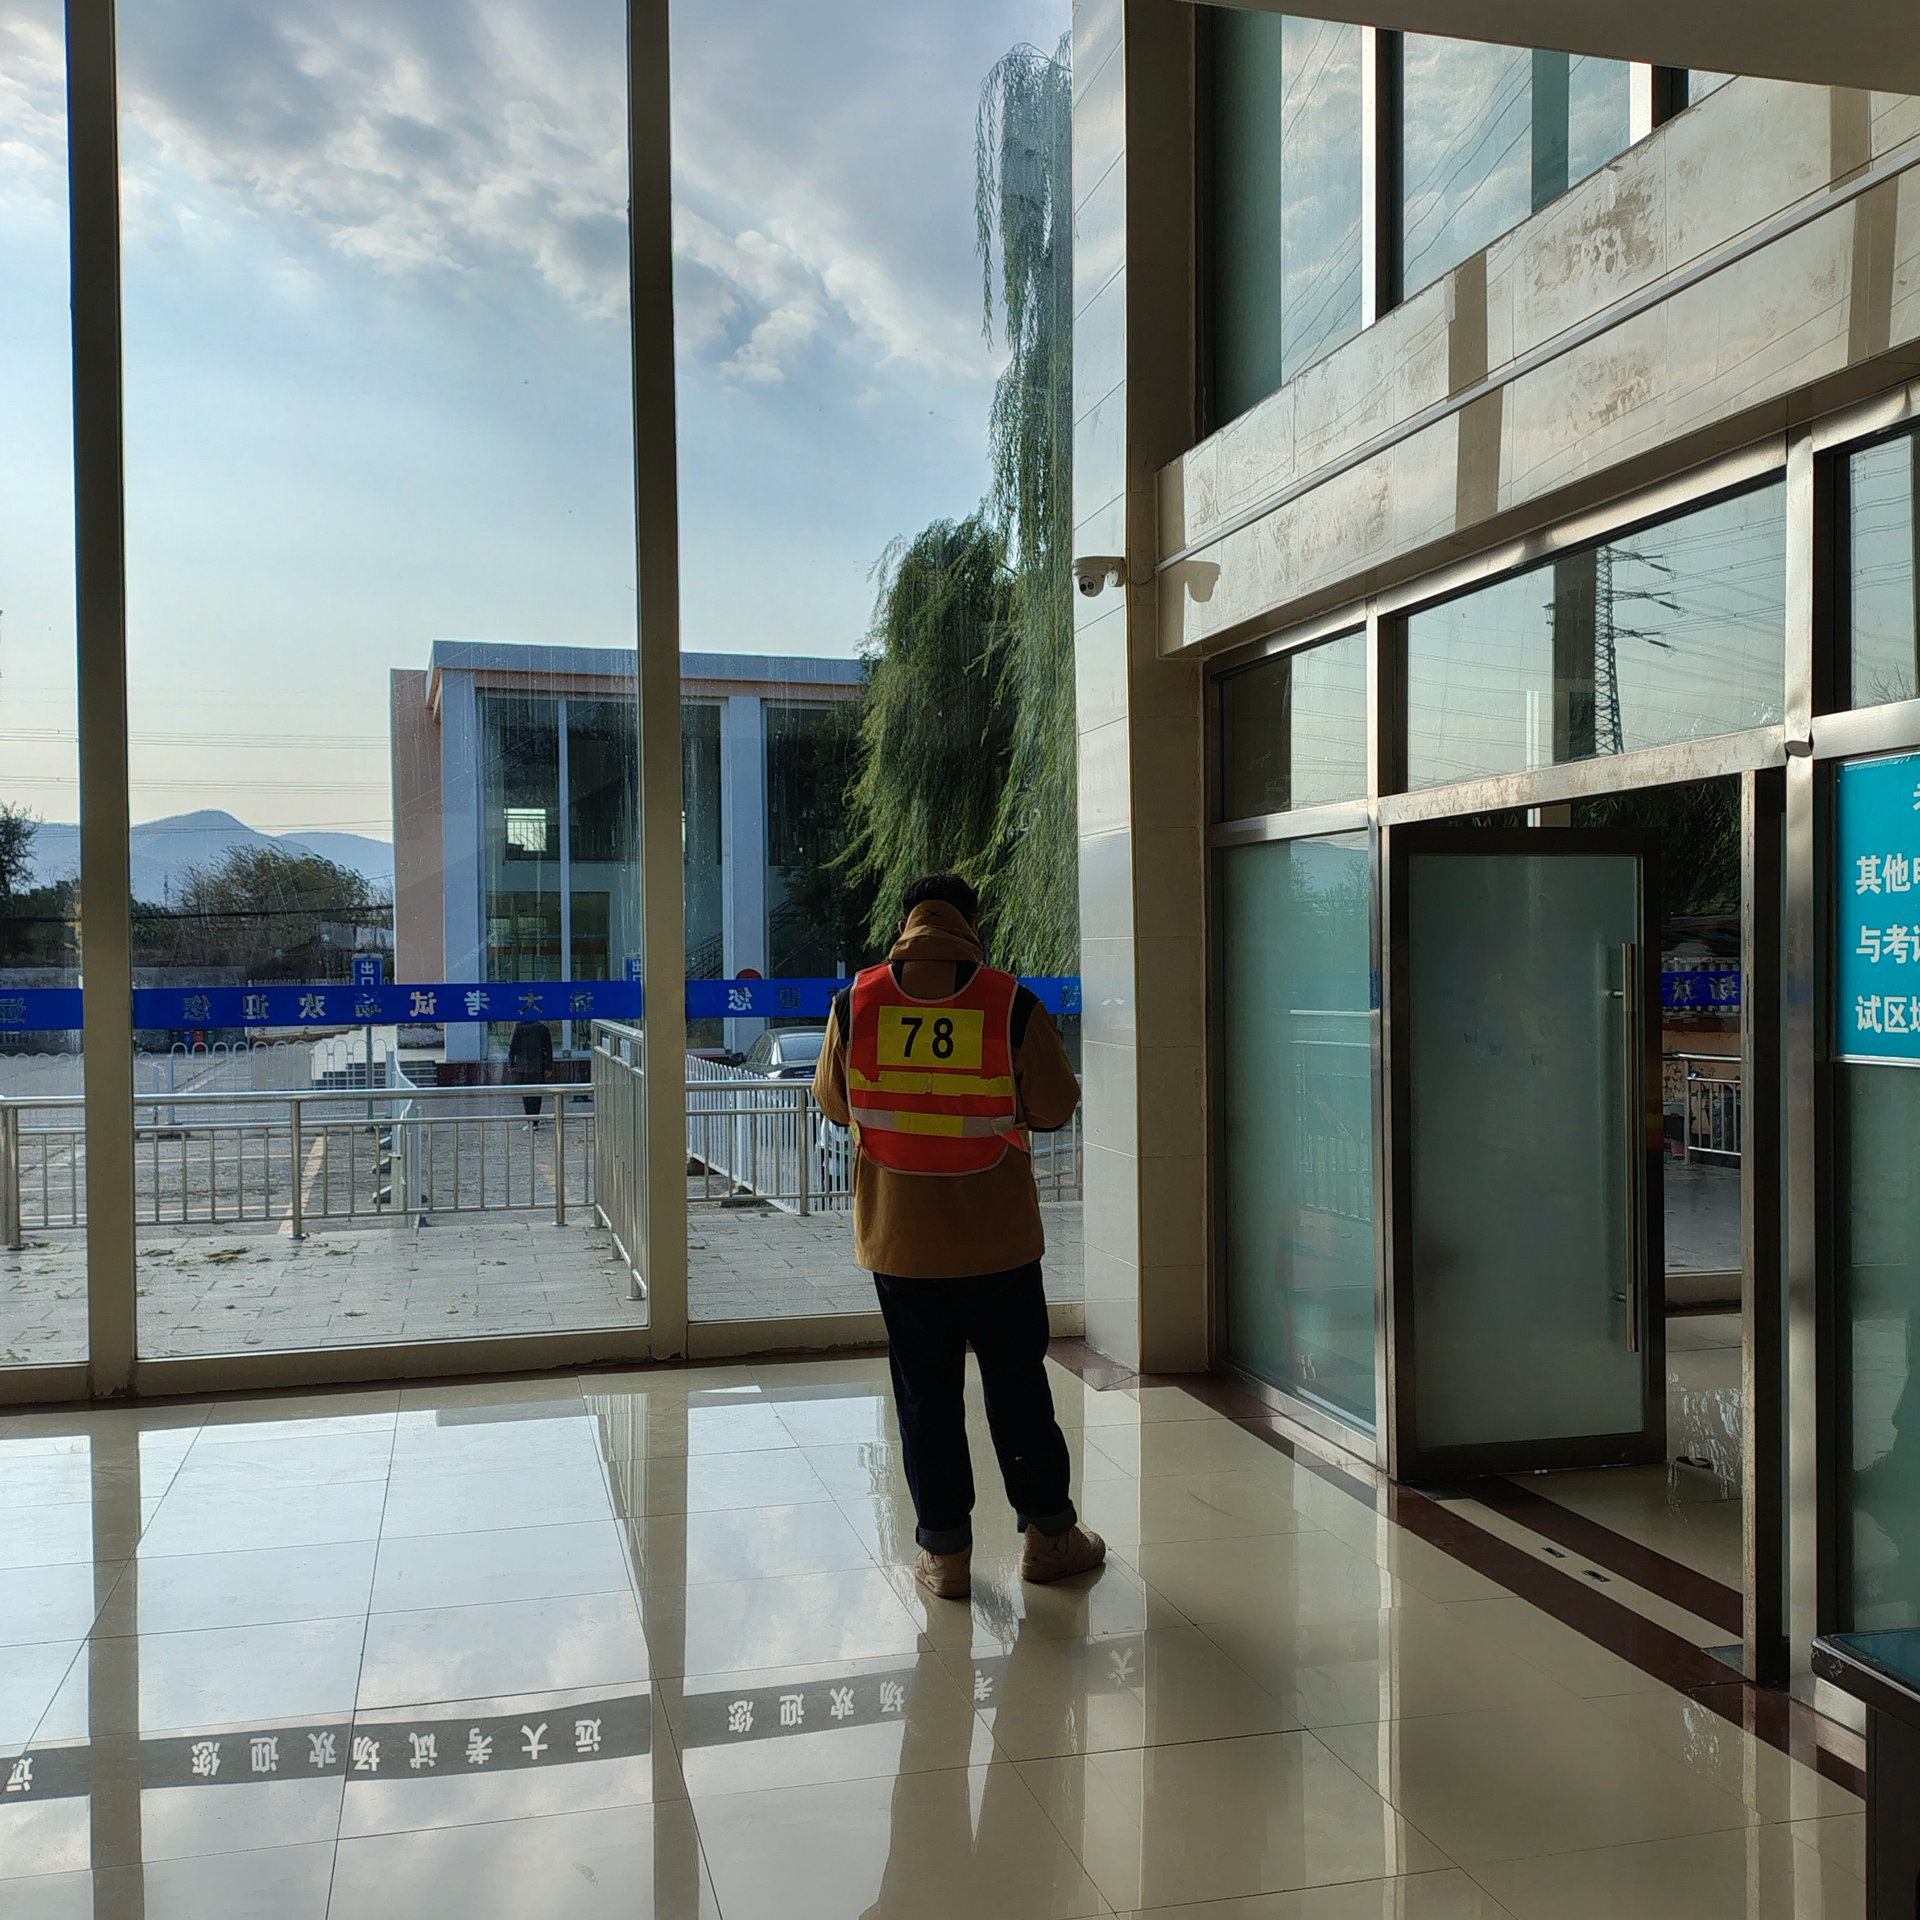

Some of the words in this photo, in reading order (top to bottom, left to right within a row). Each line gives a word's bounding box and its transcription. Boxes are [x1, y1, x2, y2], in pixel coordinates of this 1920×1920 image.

[901, 1017, 954, 1059] 78
[191, 1717, 602, 1777] 远大考试场欢迎您
